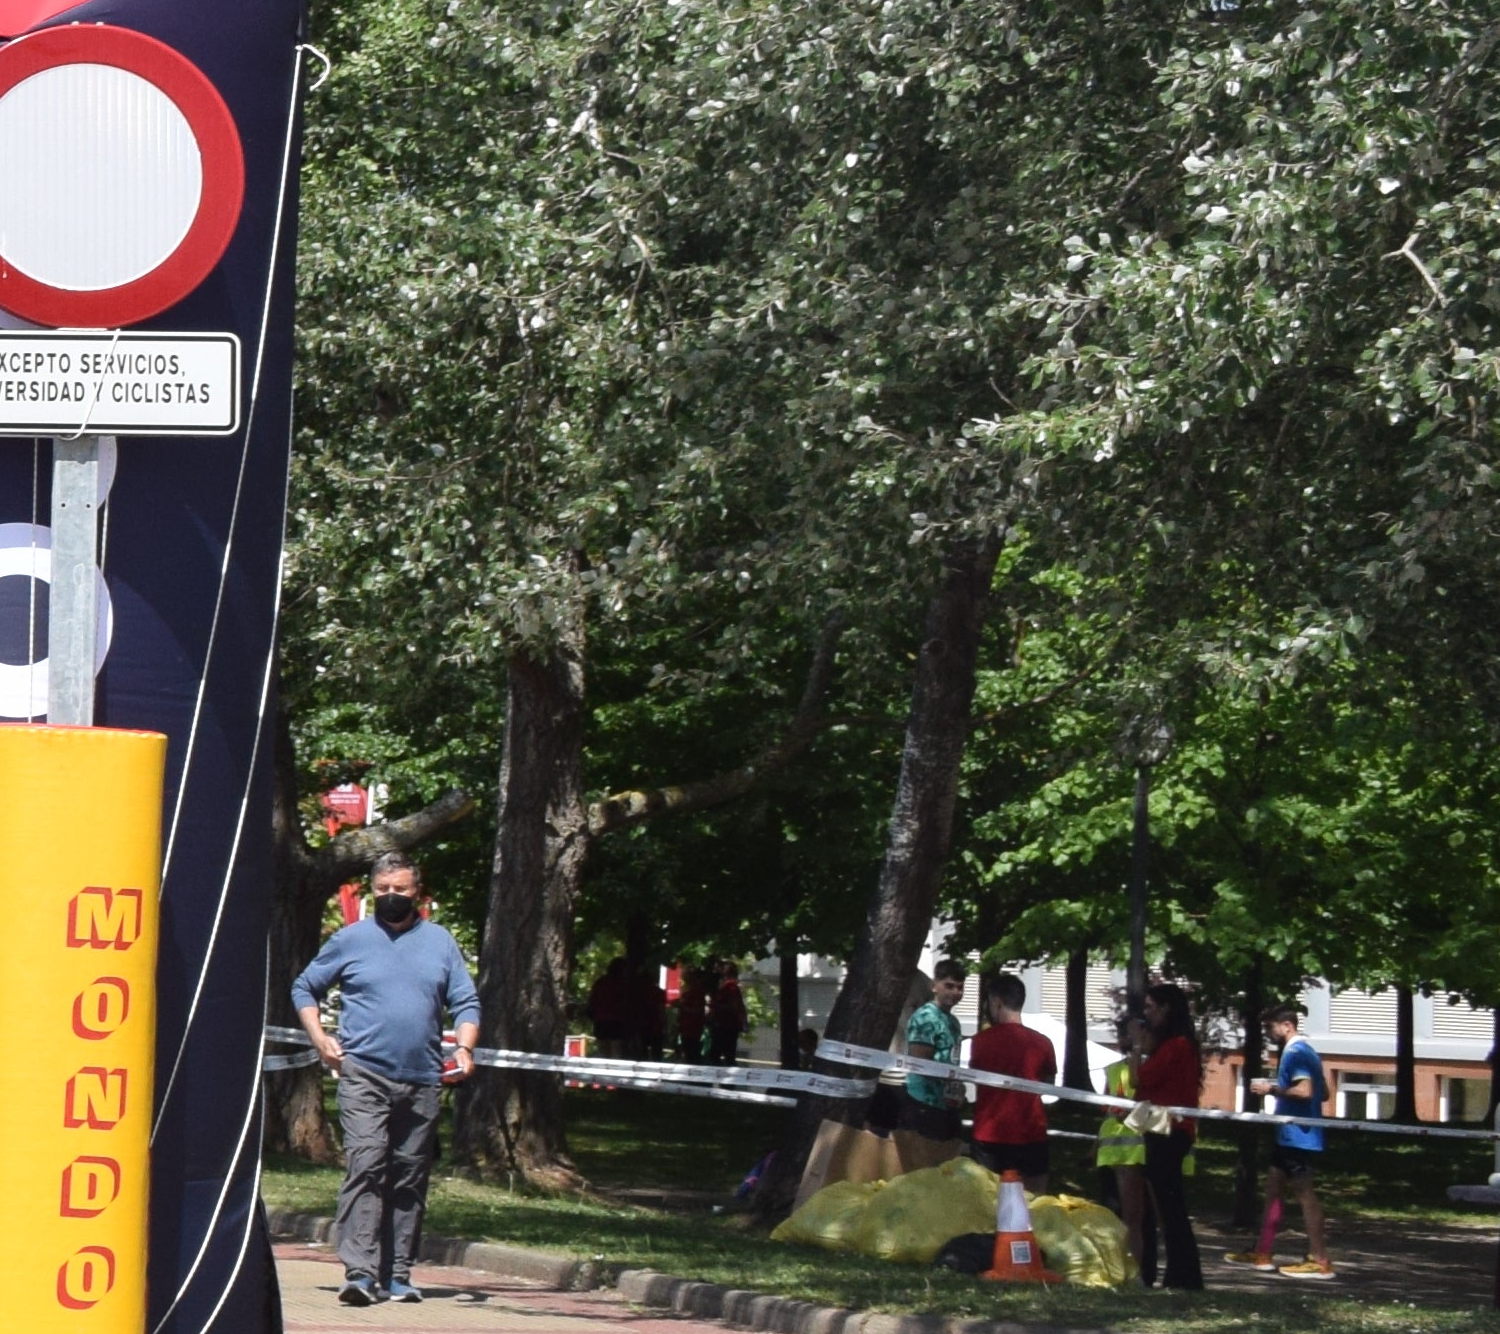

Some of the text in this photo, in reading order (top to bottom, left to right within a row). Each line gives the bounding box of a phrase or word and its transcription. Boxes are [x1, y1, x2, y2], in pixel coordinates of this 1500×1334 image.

[80, 353, 186, 377] SERVICIOS,
[93, 382, 103, 402] Y
[112, 382, 211, 404] CICLISTAS
[56, 885, 144, 1311] MONDO
